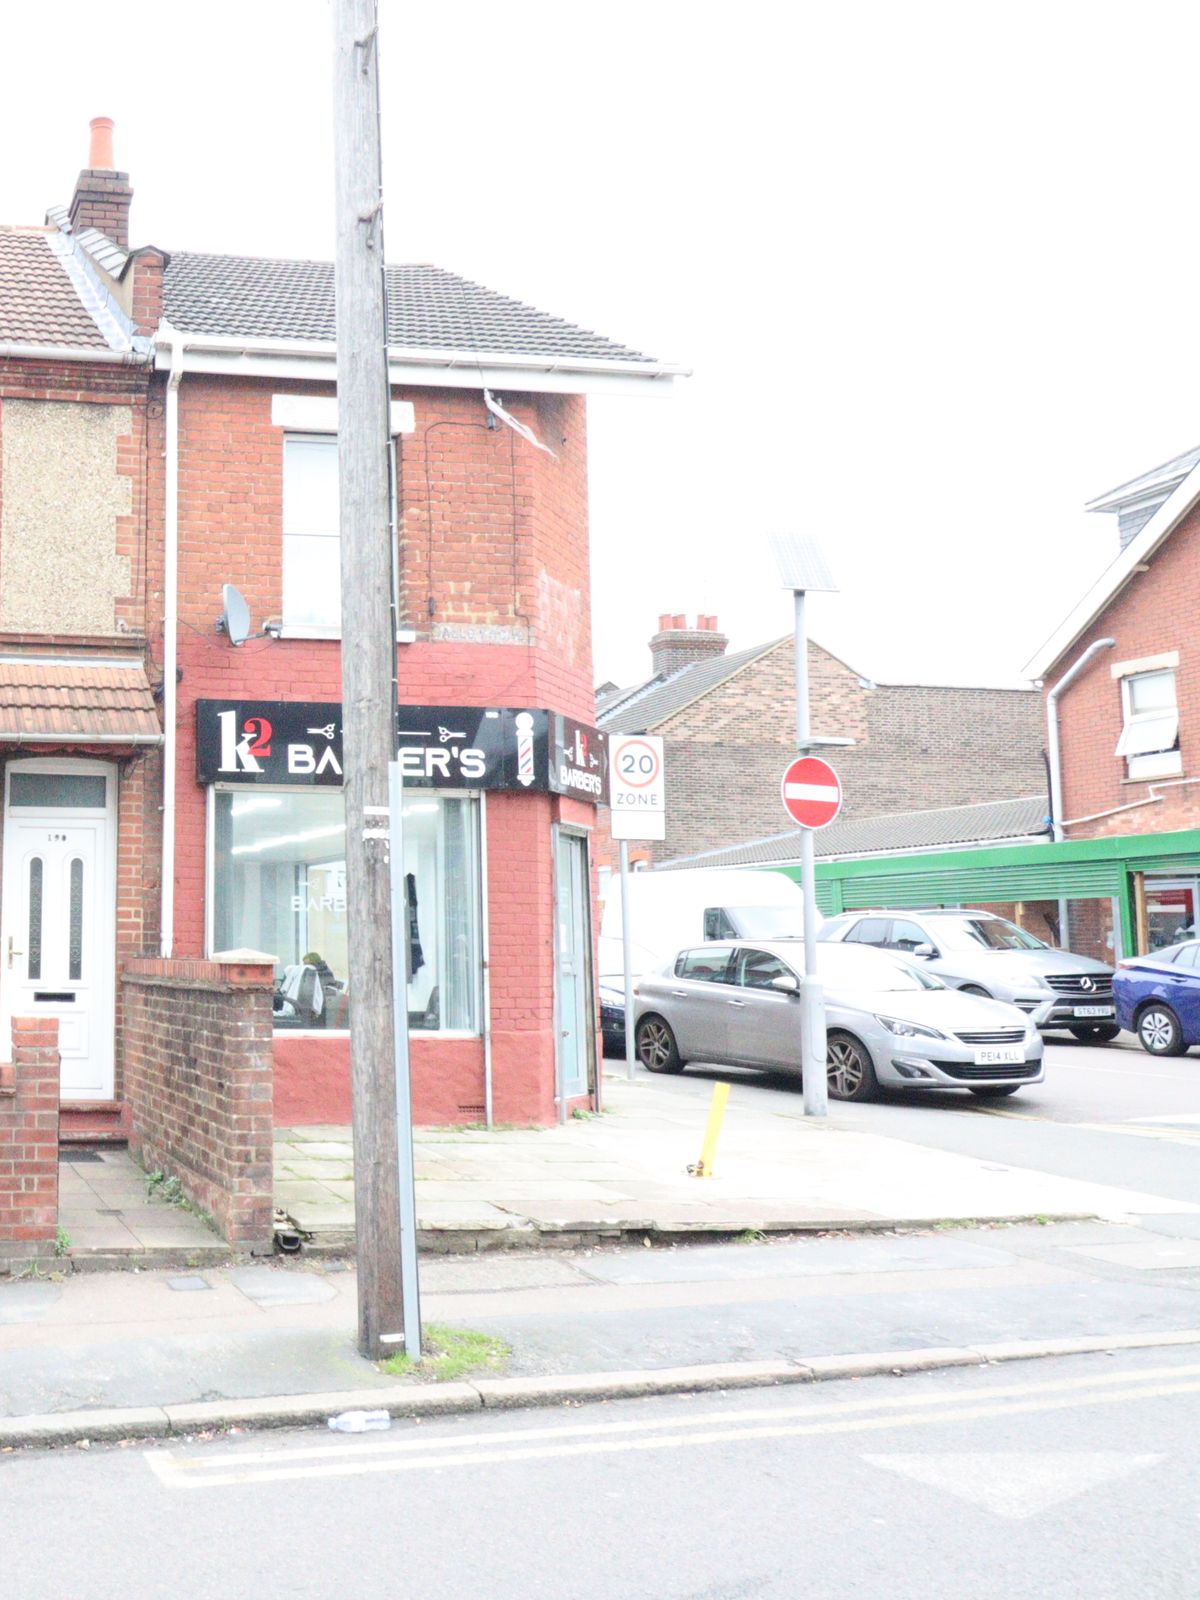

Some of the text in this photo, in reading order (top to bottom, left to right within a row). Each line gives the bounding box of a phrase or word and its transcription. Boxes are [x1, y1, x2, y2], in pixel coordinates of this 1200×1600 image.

[287, 744, 486, 778] BAER'S
[622, 754, 653, 774] 20
[616, 793, 658, 806] ZONE
